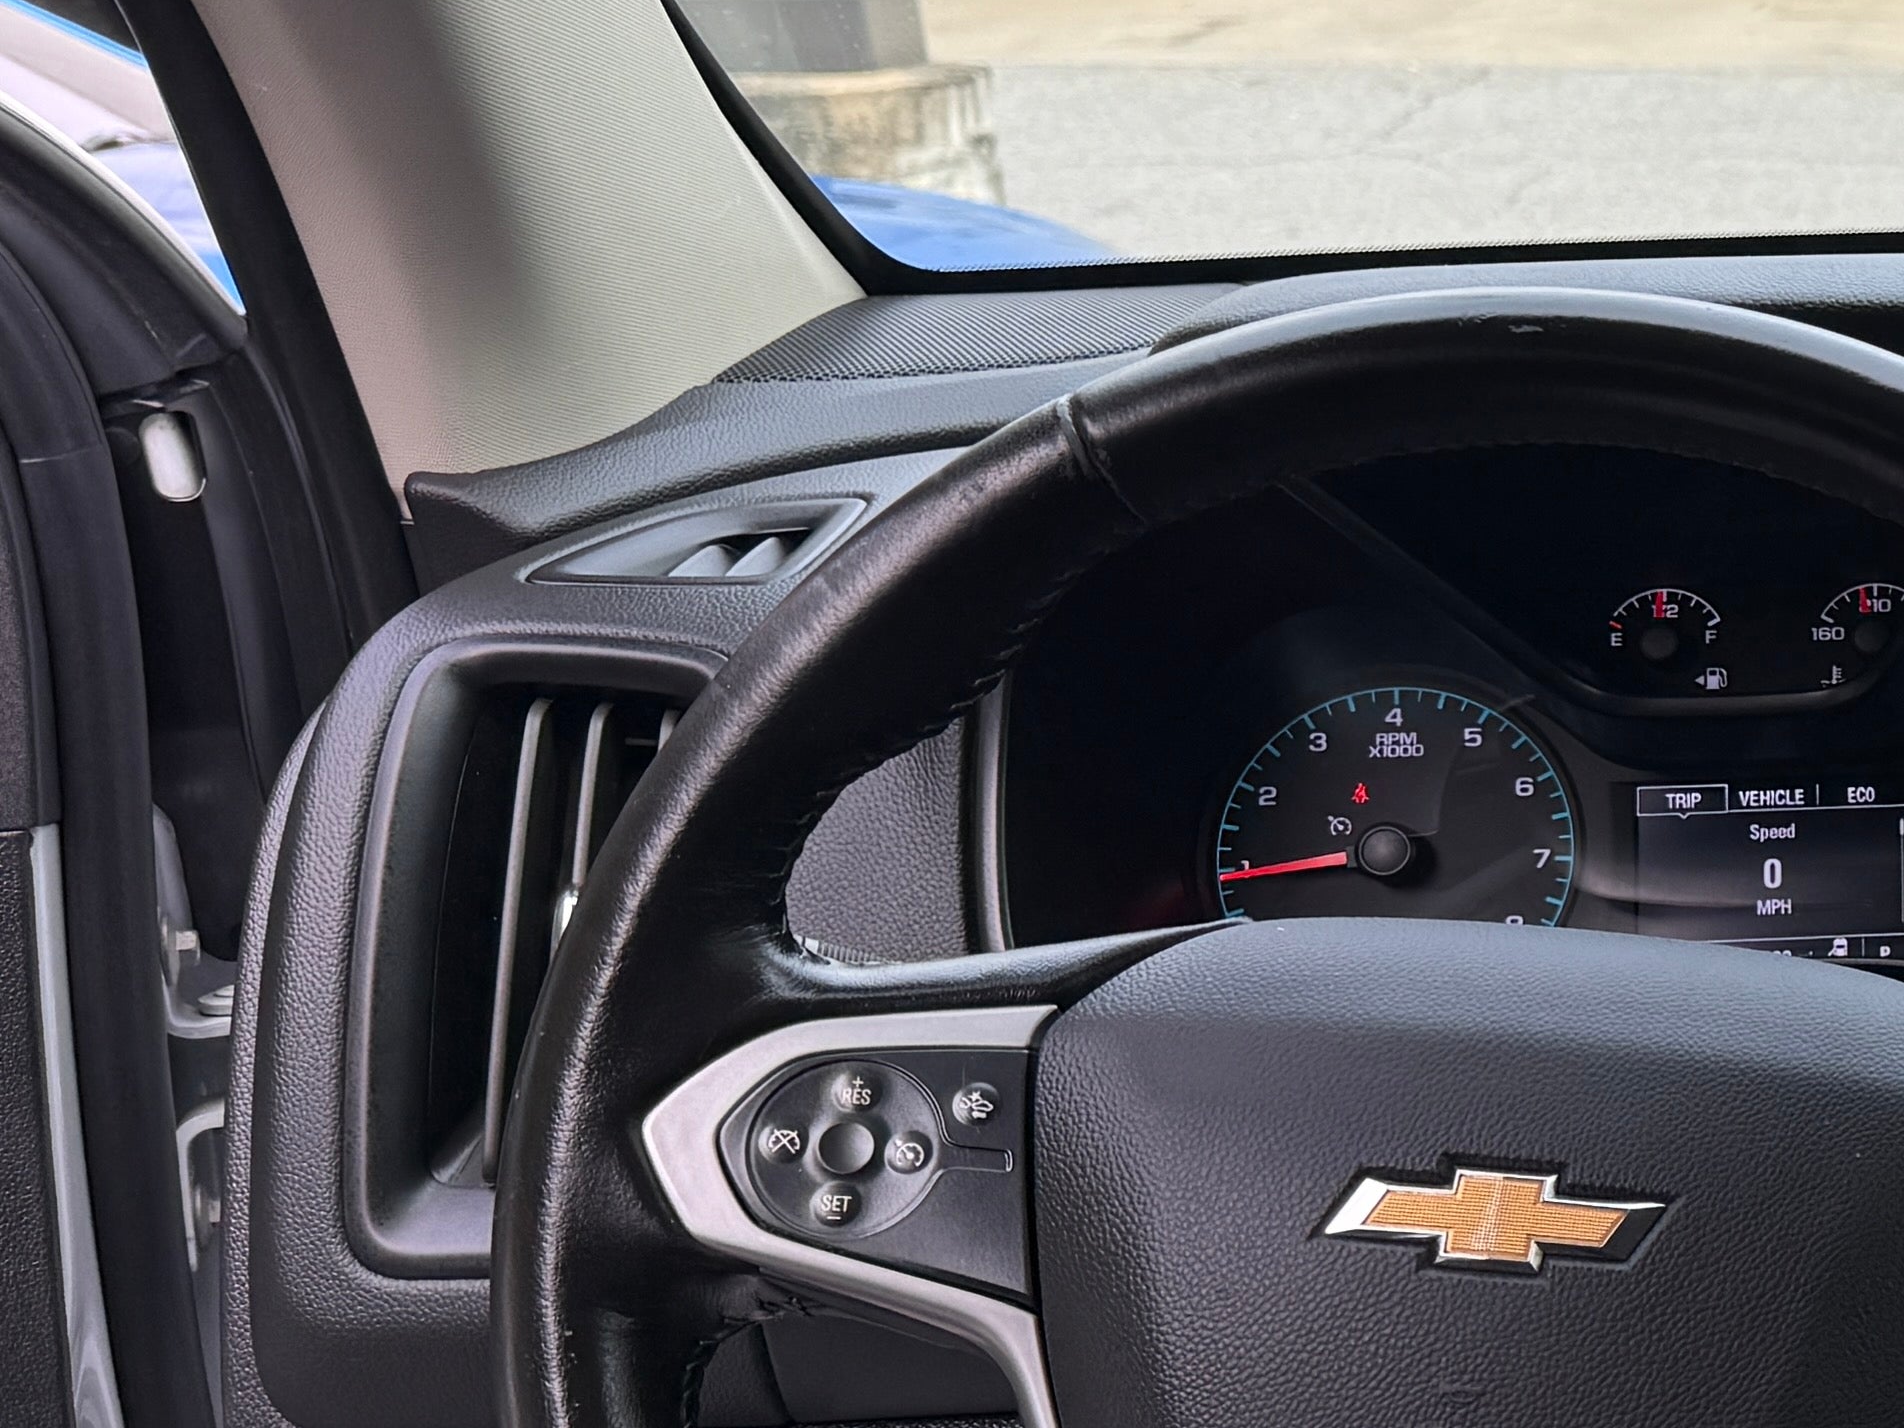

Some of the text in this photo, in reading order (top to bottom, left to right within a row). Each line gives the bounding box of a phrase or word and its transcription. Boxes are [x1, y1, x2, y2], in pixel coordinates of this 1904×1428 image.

[1610, 632, 1623, 647] E
[1705, 629, 1718, 644] F
[1811, 627, 1845, 641] 160
[1384, 707, 1404, 727] 4
[1308, 732, 1329, 753] 3
[1375, 732, 1418, 746] RPM
[1463, 727, 1483, 748] 5
[1368, 744, 1425, 759] X1000
[1257, 786, 1278, 807] 2
[1514, 776, 1535, 798] 6
[1665, 785, 1876, 811] TRIP VEHICLE ECO
[1748, 822, 1796, 842] Speed
[1532, 849, 1552, 870] 7
[1762, 858, 1783, 890] 0
[1755, 897, 1793, 917] MPH
[842, 1087, 872, 1106] RES
[821, 1194, 853, 1213] SET
